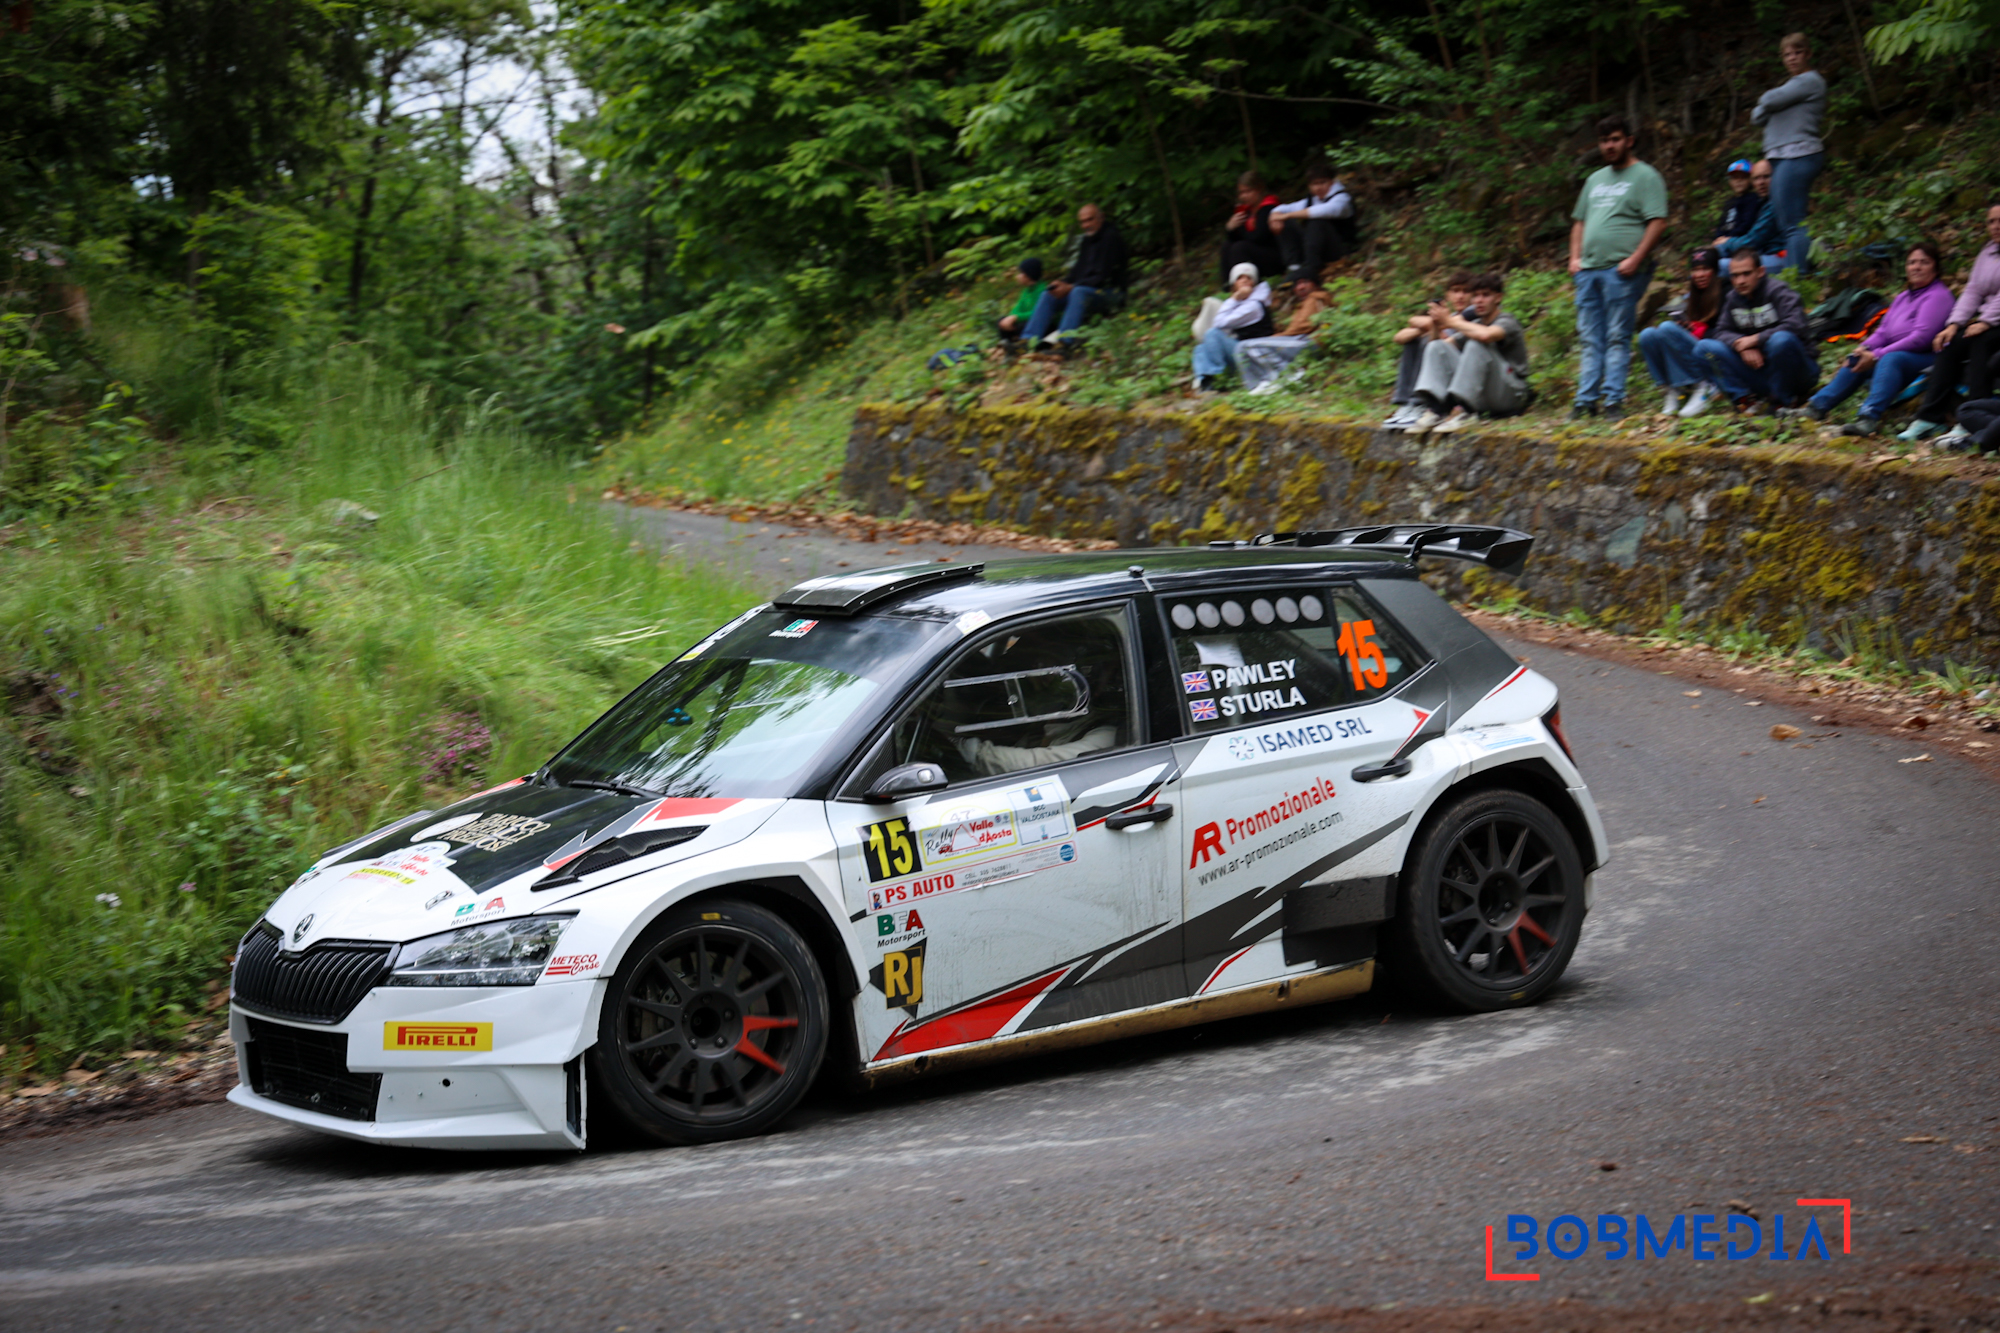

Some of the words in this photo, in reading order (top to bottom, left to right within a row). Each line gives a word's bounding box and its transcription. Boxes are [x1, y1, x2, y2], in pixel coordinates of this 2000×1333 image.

[1336, 619, 1388, 691] 15
[1210, 659, 1297, 690] PAWLEY
[1220, 686, 1307, 717] STURLA
[1257, 724, 1333, 753] ISAMED
[1335, 717, 1372, 741] SRL
[1021, 809, 1060, 824] VALDOSTANA
[1225, 776, 1337, 845] Promozionale
[969, 819, 994, 833] Valle
[869, 819, 913, 878] 15
[925, 828, 954, 856] Rally
[1198, 811, 1344, 886] www.ar-promozionale.com
[885, 885, 907, 904] PS
[913, 874, 955, 897] AUTO
[450, 907, 506, 926] Motorsport
[455, 896, 505, 917] BFA
[877, 909, 924, 937] BFA
[877, 929, 926, 948] Motorsport
[550, 954, 598, 965] METECO
[570, 961, 600, 976] Corse
[884, 951, 921, 1005] RJ
[397, 1026, 478, 1046] PIRELLI
